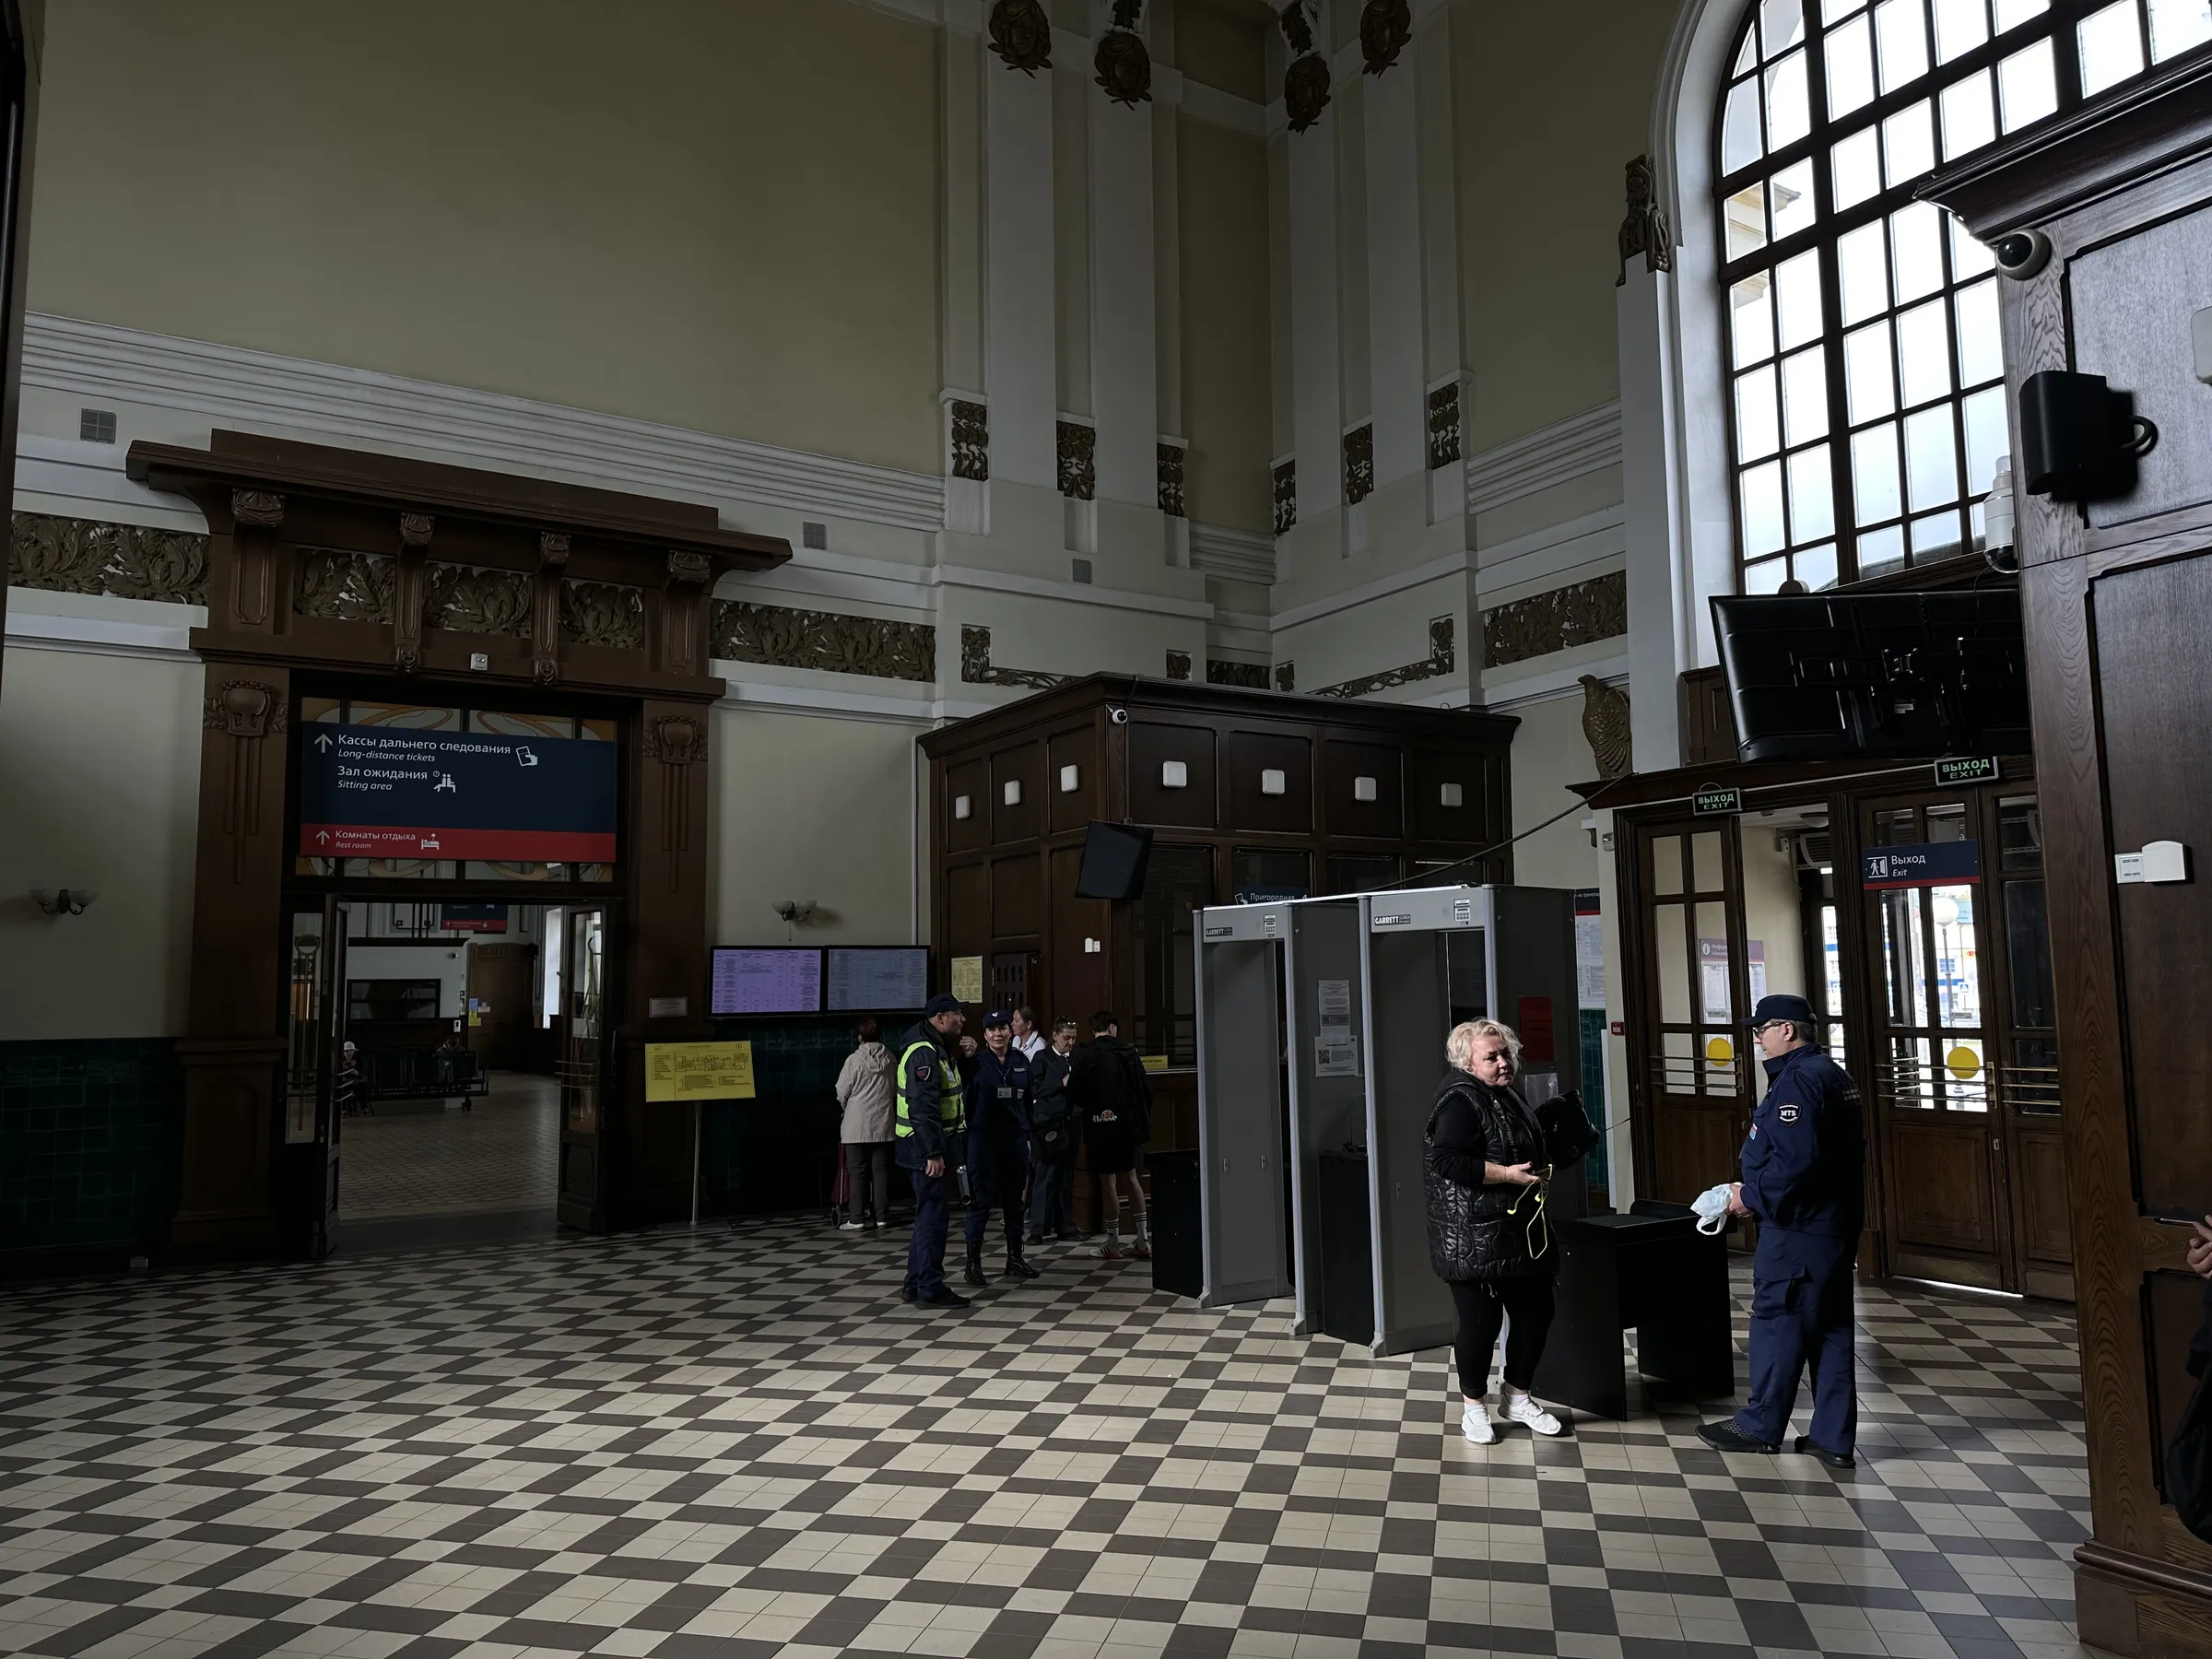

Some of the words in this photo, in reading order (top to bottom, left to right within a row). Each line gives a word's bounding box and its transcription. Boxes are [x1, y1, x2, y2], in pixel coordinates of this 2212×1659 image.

[338, 734, 376, 747] Кассы
[379, 738, 437, 750] дальнего
[440, 741, 511, 754] следования
[338, 748, 405, 760] Long-distance
[406, 752, 436, 762] tickets
[1942, 759, 1990, 773] ВЫХОД
[337, 765, 360, 776] Зал
[363, 769, 428, 780] ожидания
[1949, 769, 1983, 780] EXIT
[337, 780, 369, 792] Sitting
[1698, 793, 1735, 805] ВЫХОД
[1703, 802, 1729, 810] EXIT
[335, 830, 380, 840] Комнаты
[382, 832, 416, 841] отдыха
[1891, 854, 1926, 865] Выход
[1892, 868, 1908, 877] Exit
[1250, 892, 1295, 902] Пригородная
[1375, 916, 1399, 925] GARRETT
